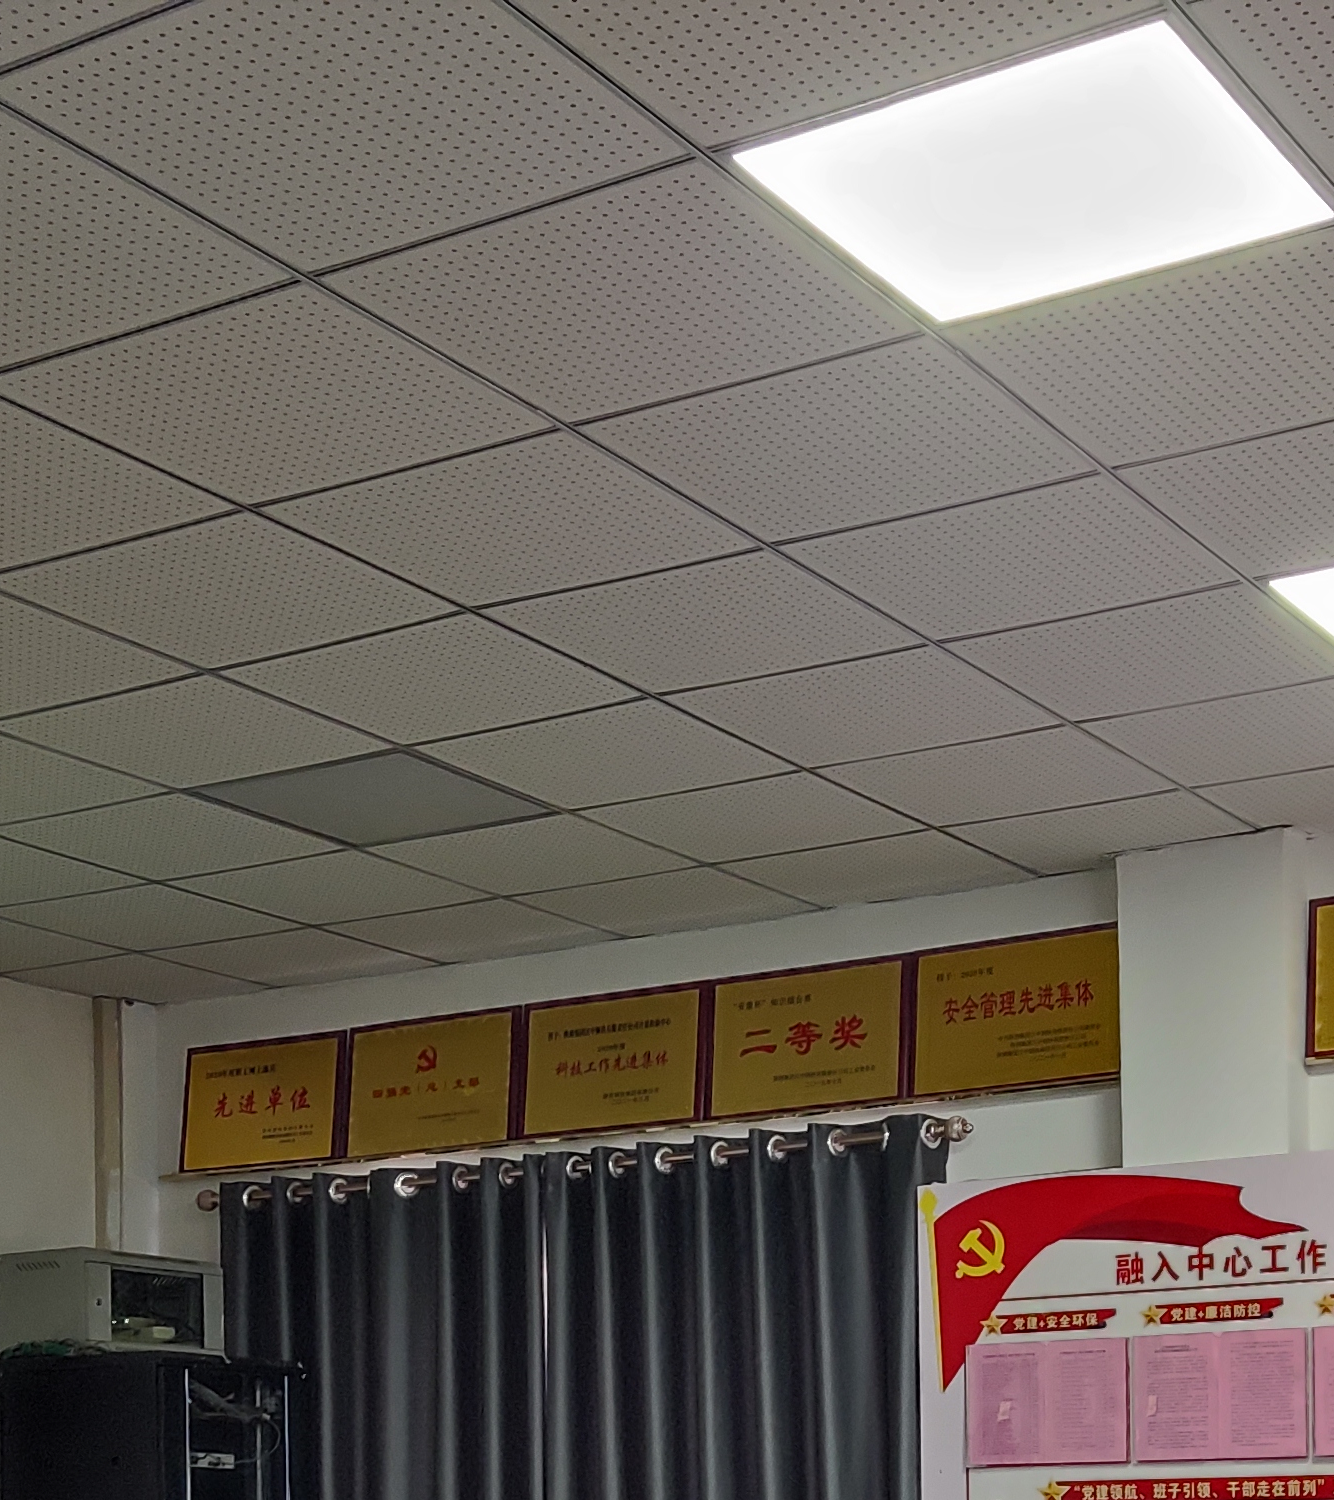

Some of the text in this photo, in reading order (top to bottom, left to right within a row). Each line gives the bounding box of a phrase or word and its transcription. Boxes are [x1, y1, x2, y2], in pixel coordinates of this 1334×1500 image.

[942, 978, 1094, 1026] 安全管理先进集体
[739, 1013, 868, 1058] 二等奖
[214, 1084, 311, 1119] 先进单位
[1115, 1239, 1327, 1286] 融入中心工作
[1013, 1312, 1099, 1331] 党建+安全环保
[1170, 1302, 1262, 1322] 党建+廉洁防控
